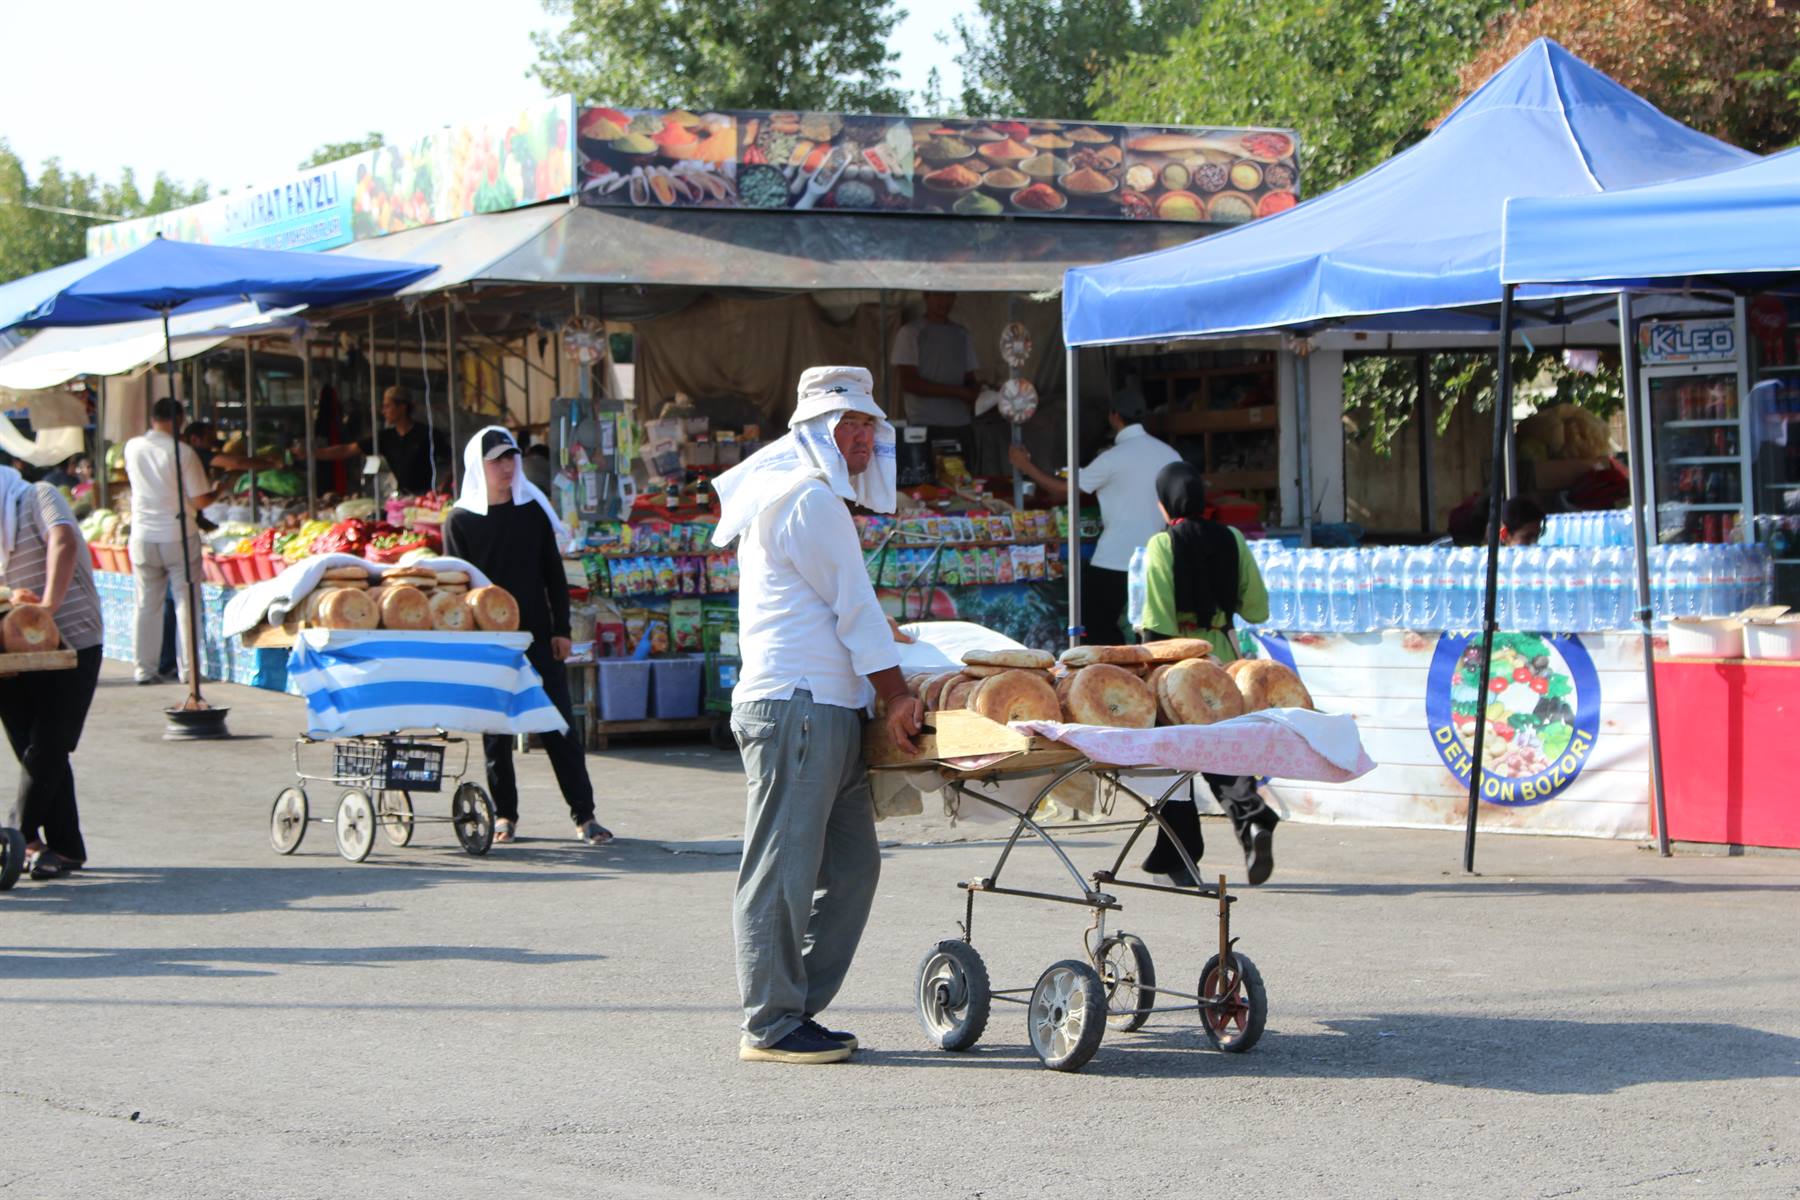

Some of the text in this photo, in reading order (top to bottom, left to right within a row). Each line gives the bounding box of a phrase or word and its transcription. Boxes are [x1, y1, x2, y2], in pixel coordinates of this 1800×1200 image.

[285, 171, 339, 214] FAYZLI
[1651, 325, 1734, 355] KLEO
[1520, 728, 1593, 802] BOZORI
